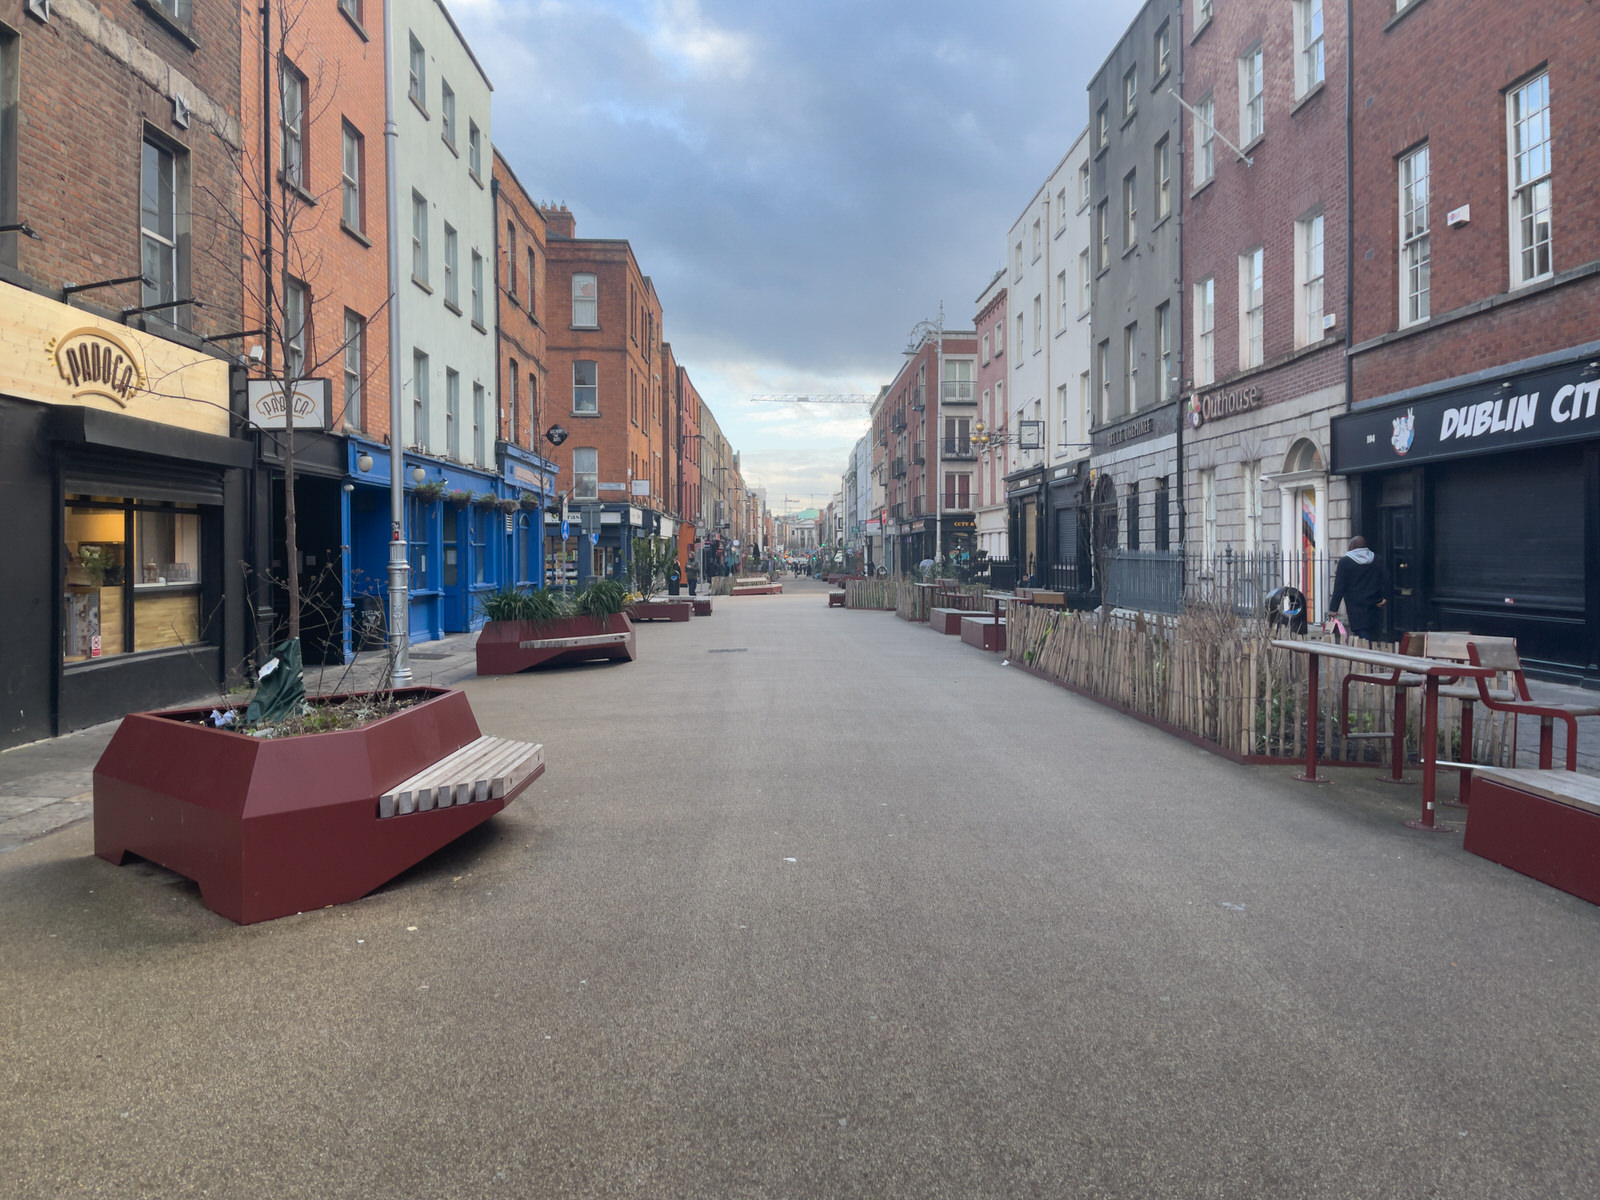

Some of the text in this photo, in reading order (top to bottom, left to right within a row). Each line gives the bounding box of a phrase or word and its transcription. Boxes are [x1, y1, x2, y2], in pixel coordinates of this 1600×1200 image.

[66, 342, 133, 398] PADOCA
[262, 396, 309, 416] PADCA
[1202, 385, 1257, 420] Outhouse
[1439, 391, 1540, 442] DUBLIN
